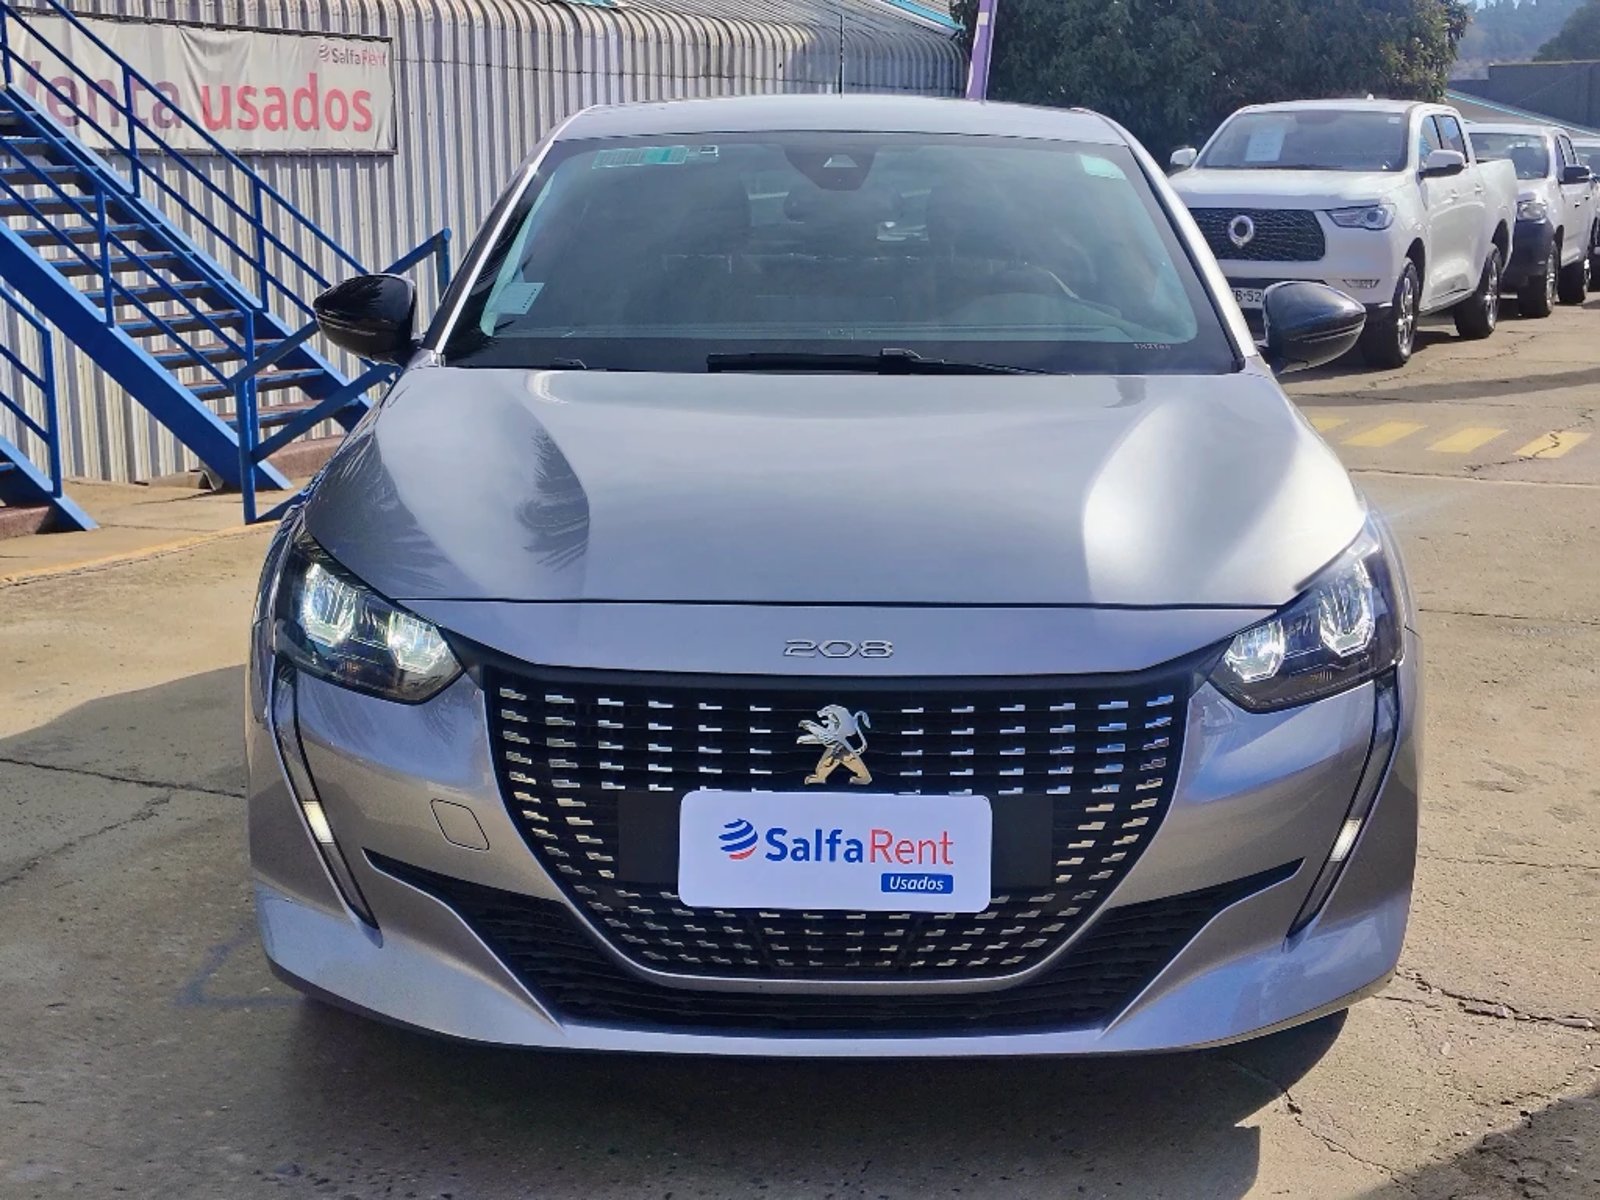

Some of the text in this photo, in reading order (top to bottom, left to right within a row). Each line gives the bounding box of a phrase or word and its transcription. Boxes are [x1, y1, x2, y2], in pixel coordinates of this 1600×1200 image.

[332, 47, 386, 66] SalfaRent
[201, 72, 373, 132] usados
[783, 639, 893, 658] 208
[765, 827, 954, 864] SalfaRent
[889, 875, 944, 891] Usados
